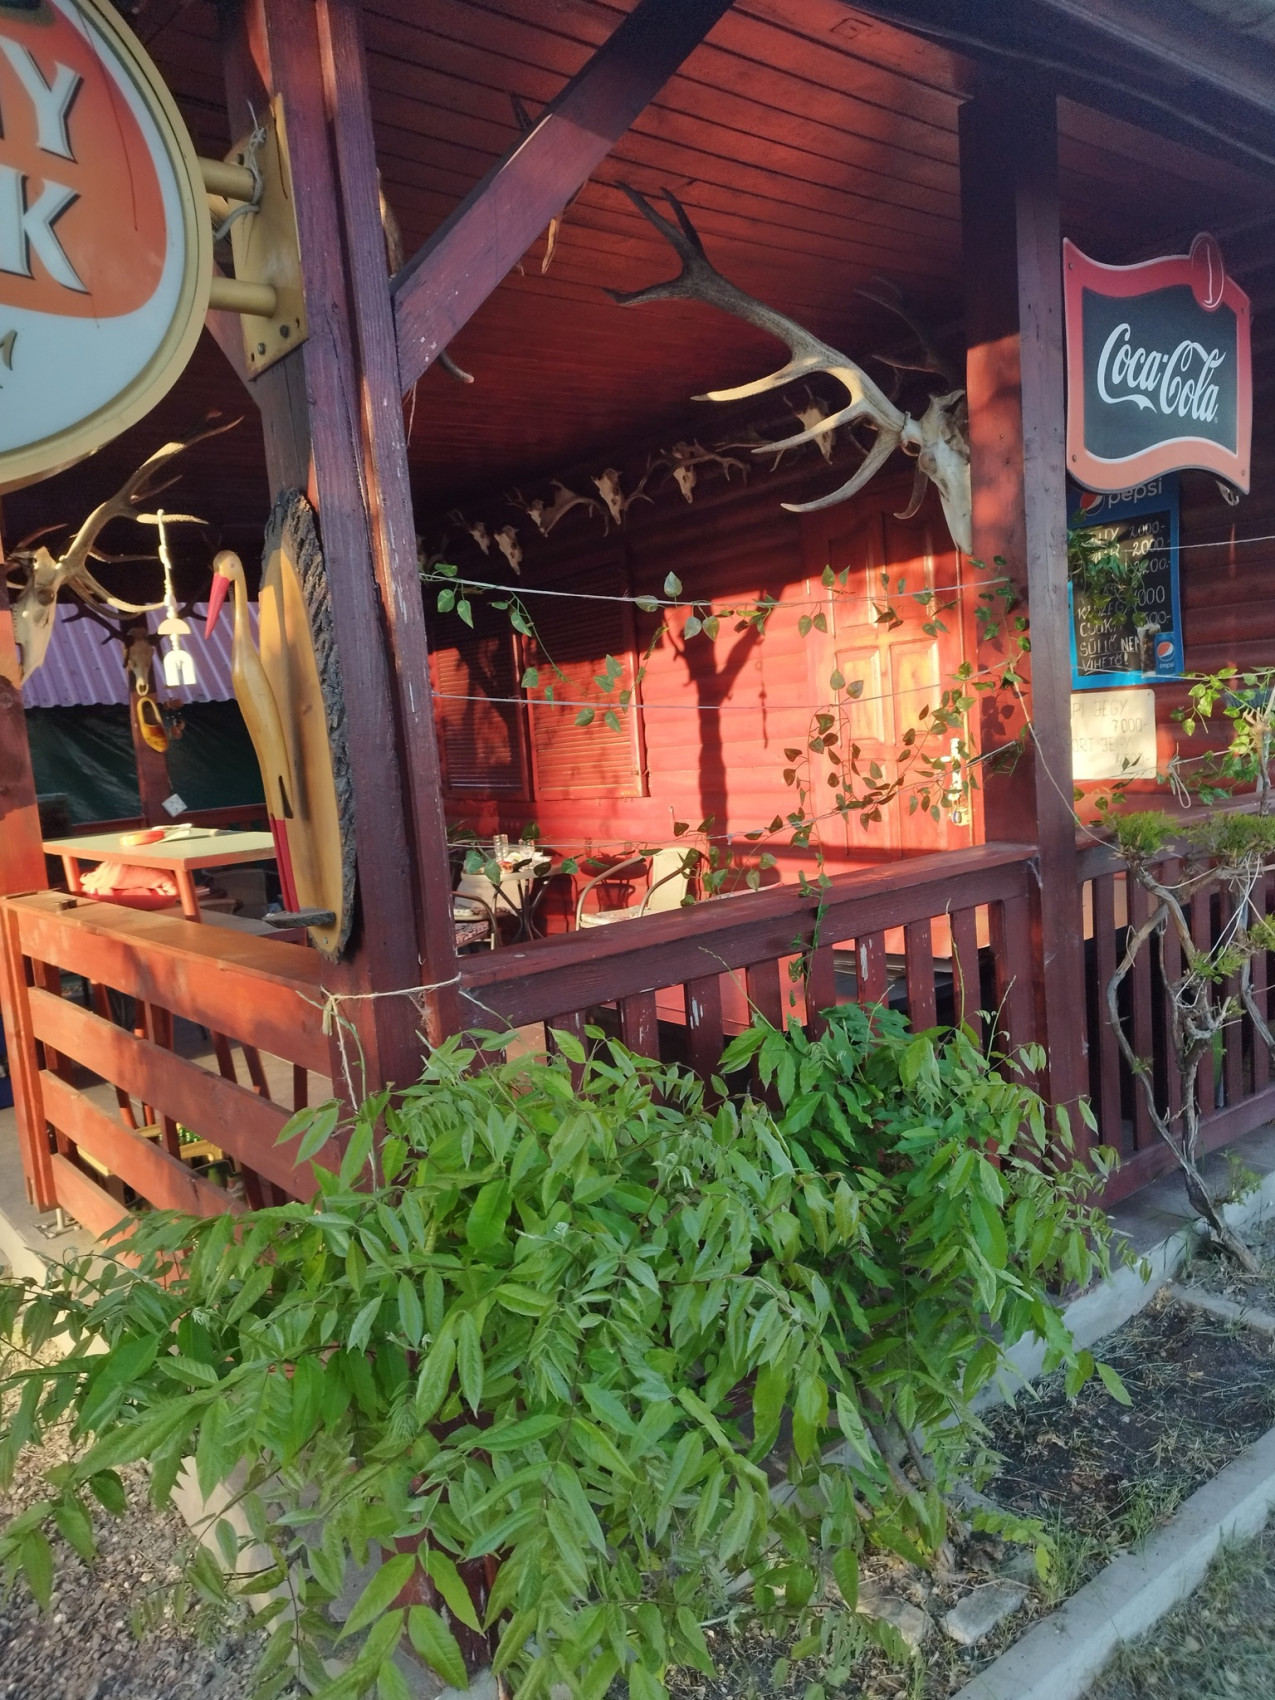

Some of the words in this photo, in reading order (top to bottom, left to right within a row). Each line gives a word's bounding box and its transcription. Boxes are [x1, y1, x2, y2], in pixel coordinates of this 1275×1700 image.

[0, 34, 85, 164] Y
[0, 163, 93, 296] K
[1097, 323, 1226, 423] Coca-Cola
[1108, 477, 1163, 509] pepsi
